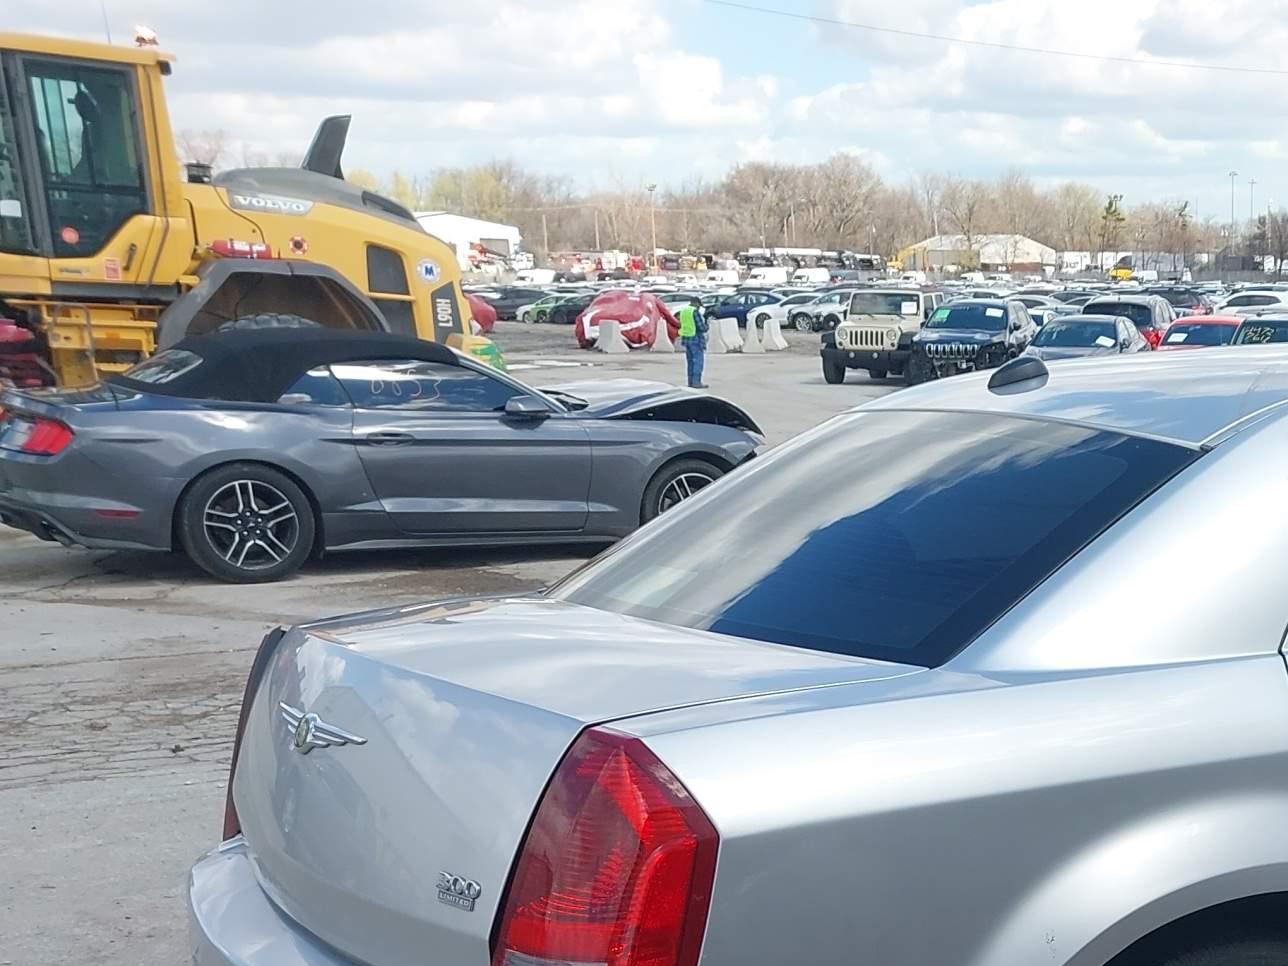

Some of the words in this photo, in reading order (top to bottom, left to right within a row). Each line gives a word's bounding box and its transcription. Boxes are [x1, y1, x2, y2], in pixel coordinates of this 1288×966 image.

[233, 195, 304, 211] VOLVO
[436, 298, 453, 327] L90H
[436, 871, 482, 900] 300
